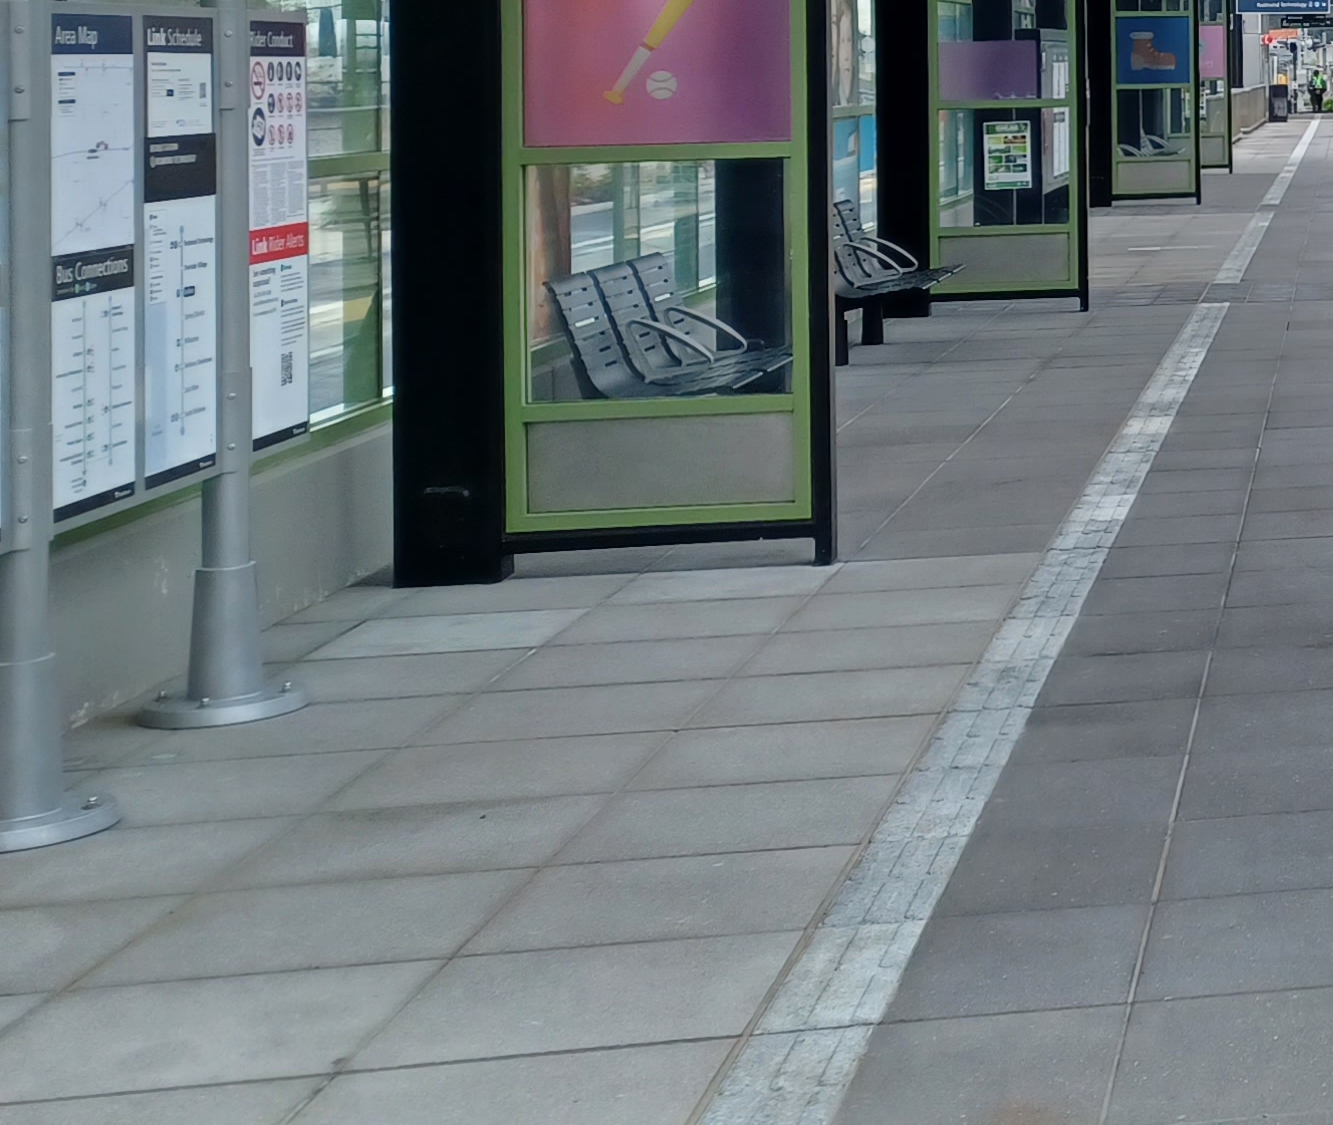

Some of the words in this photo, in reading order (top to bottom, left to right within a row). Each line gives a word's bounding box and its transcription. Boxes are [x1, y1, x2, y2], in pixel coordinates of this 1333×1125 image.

[55, 26, 76, 44] Area
[78, 26, 98, 50] Map
[146, 27, 166, 46] Link
[167, 28, 202, 47] Schedule
[267, 31, 293, 48] Conduct
[251, 238, 268, 256] Link
[268, 235, 285, 252] Rider
[285, 232, 305, 249] Alerts
[56, 265, 73, 285] Bus
[75, 257, 129, 281] Connections
